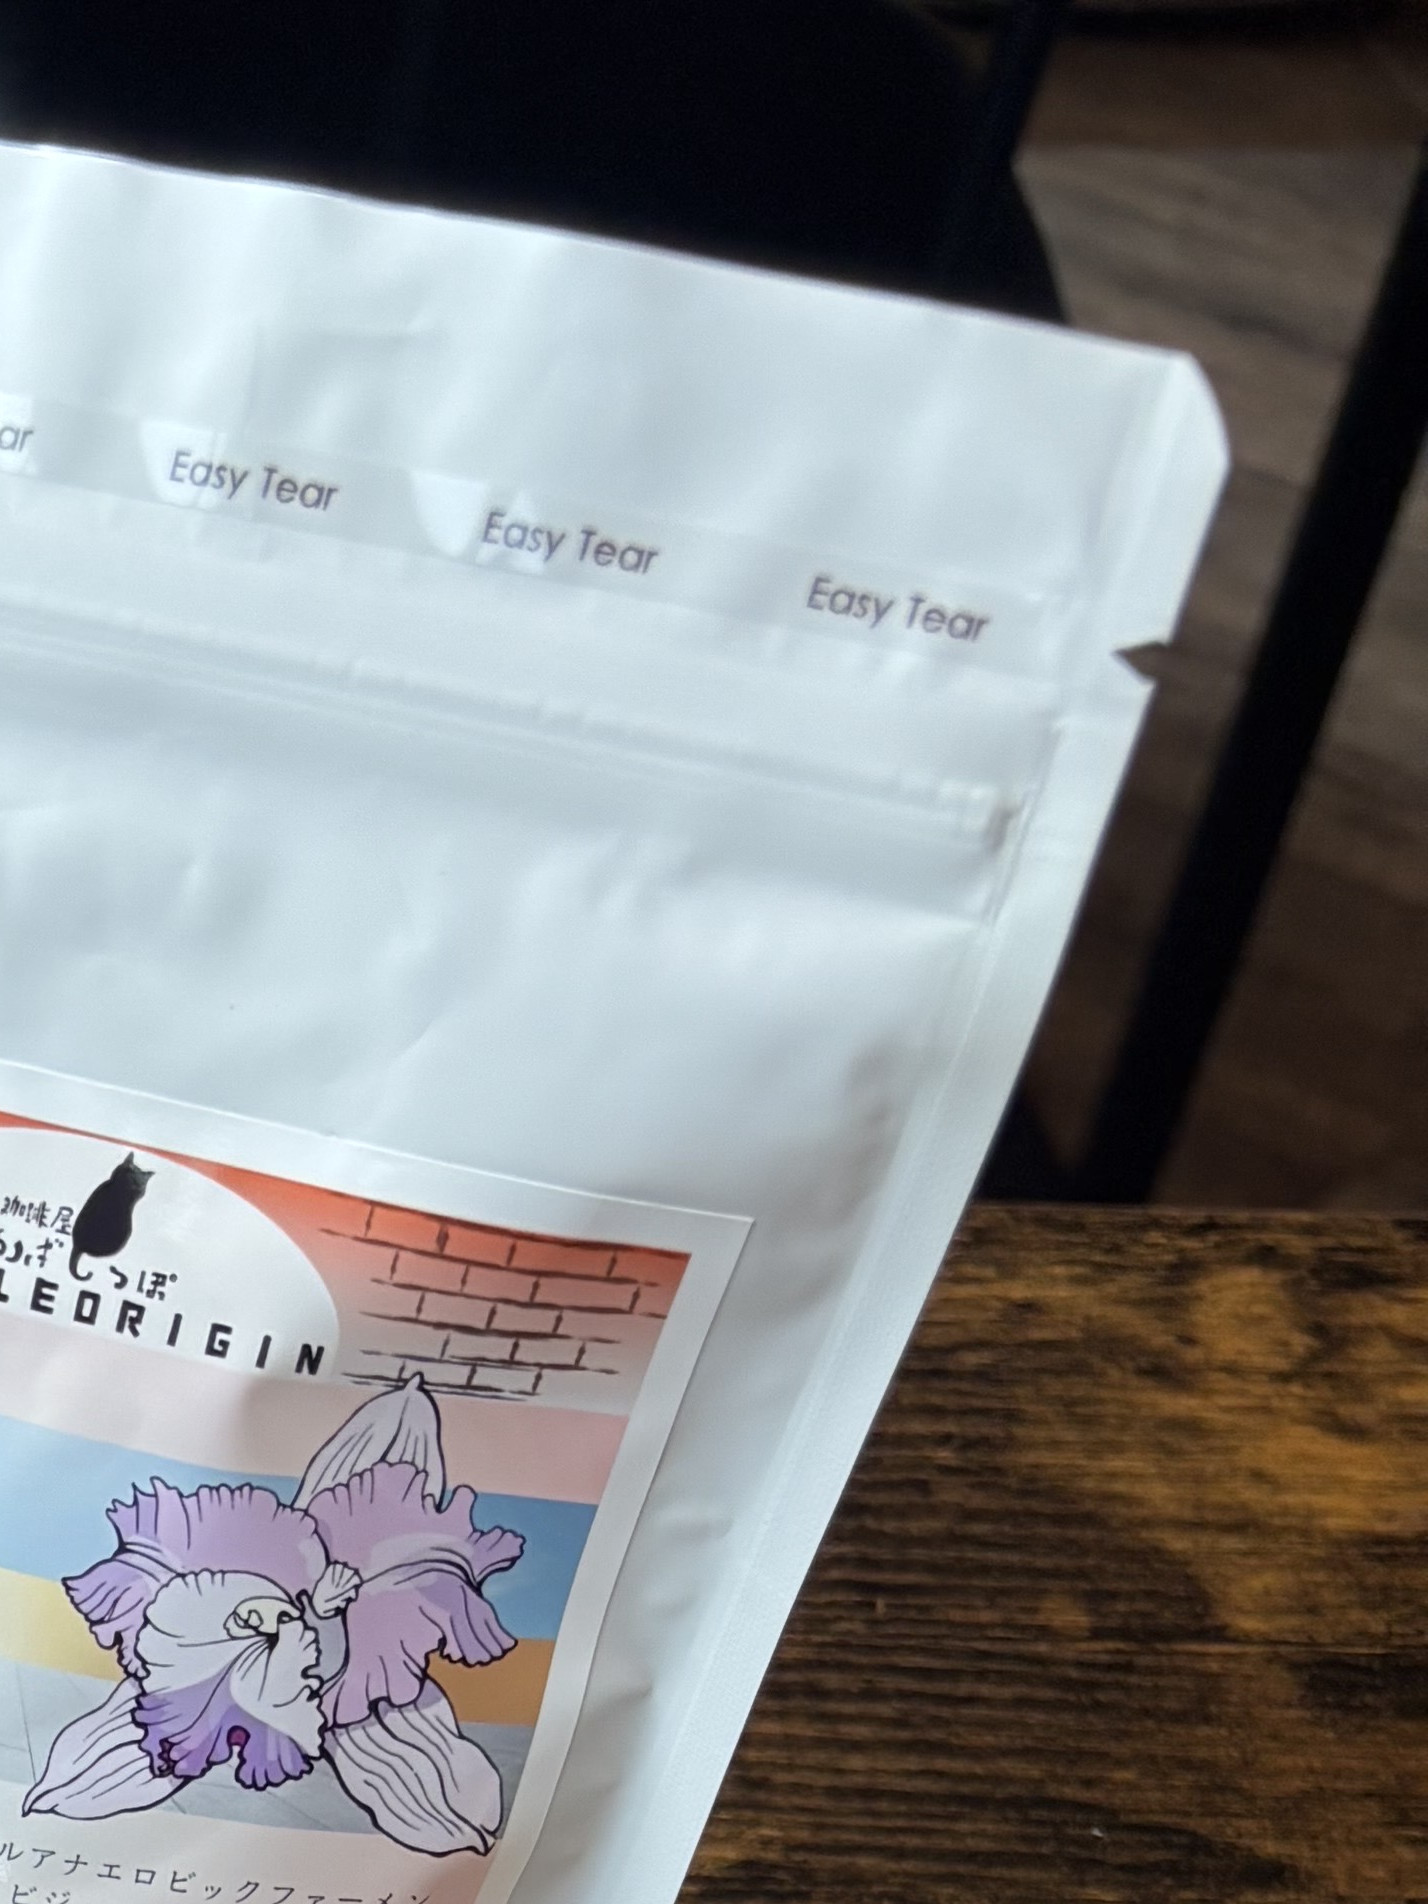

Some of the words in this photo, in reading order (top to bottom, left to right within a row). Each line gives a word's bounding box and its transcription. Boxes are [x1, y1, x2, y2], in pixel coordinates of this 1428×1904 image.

[169, 450, 248, 500] Easy
[260, 466, 339, 512] Tear
[481, 511, 565, 560] Easy
[578, 529, 660, 575] Tear
[806, 575, 895, 628] Easy
[906, 594, 990, 642] Tear
